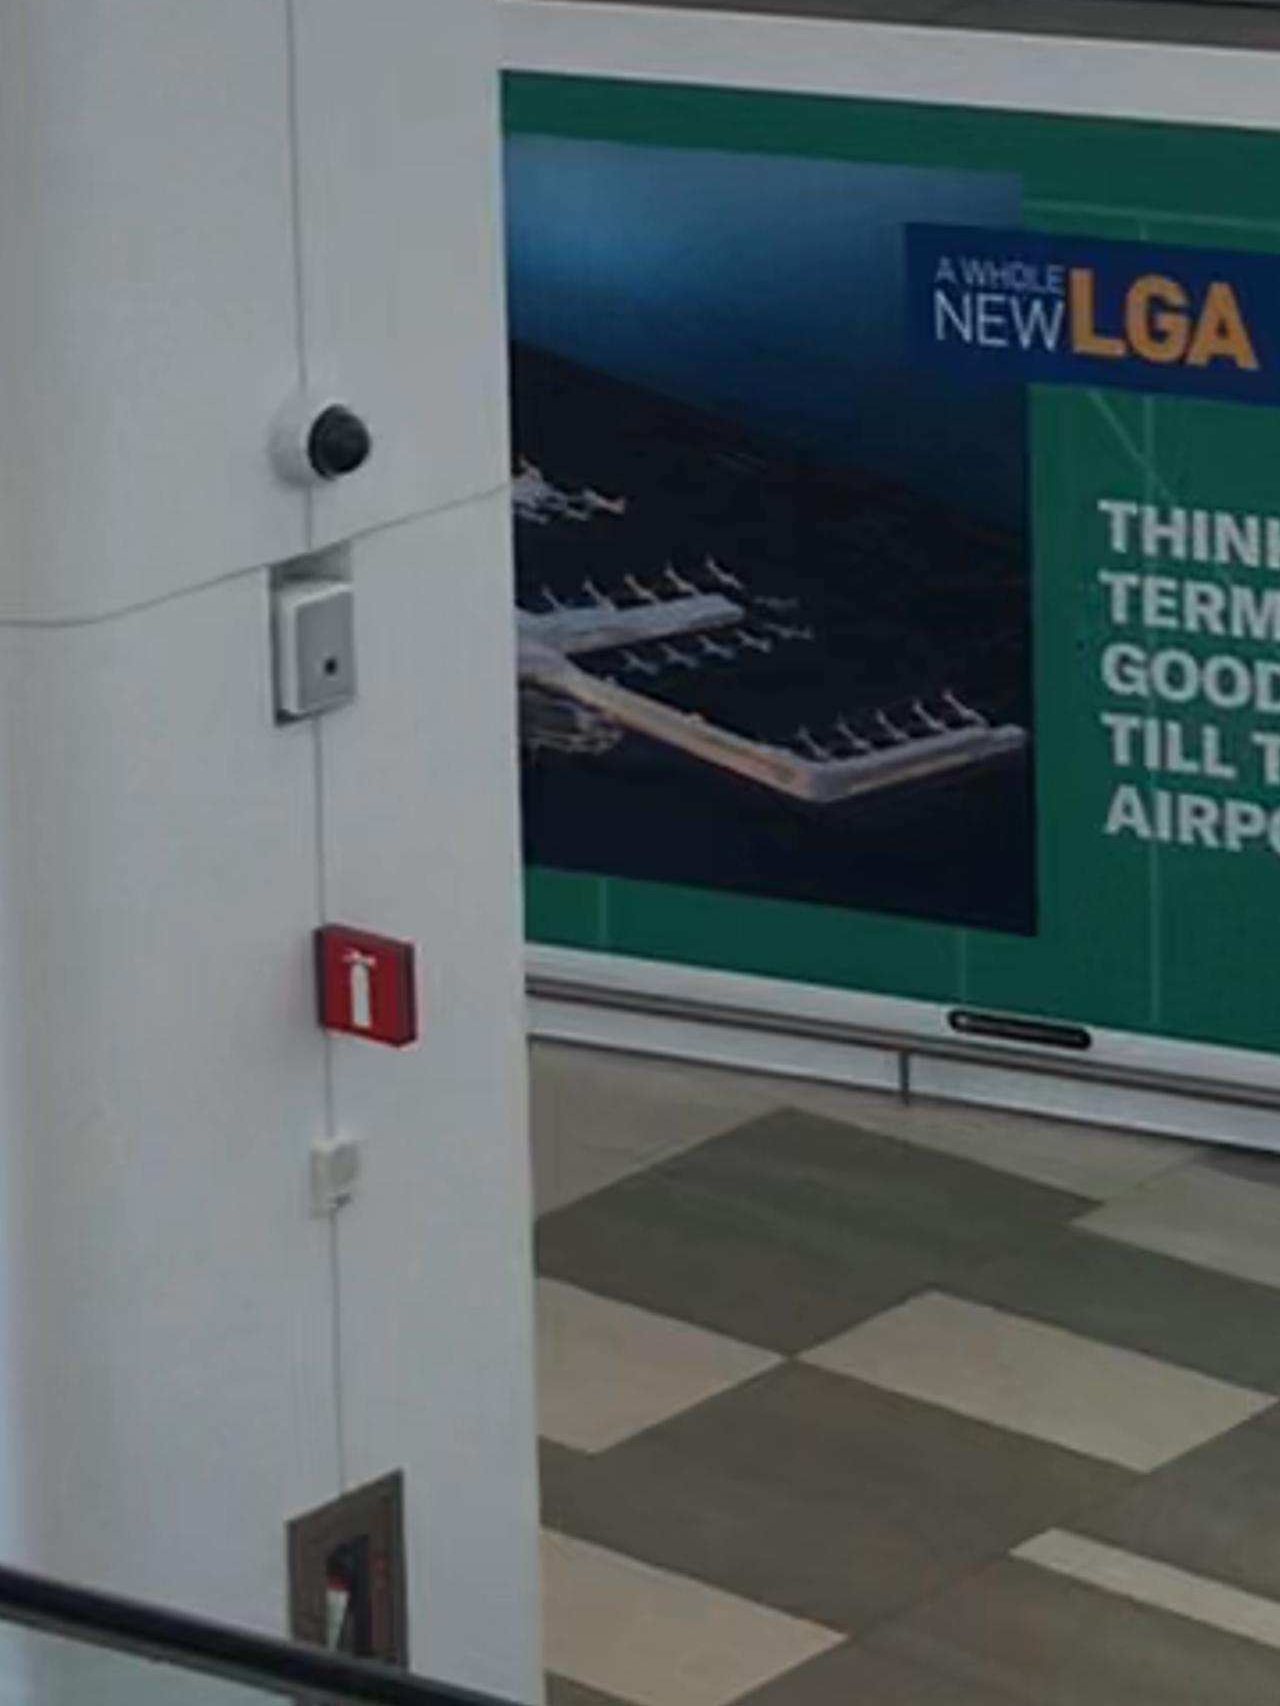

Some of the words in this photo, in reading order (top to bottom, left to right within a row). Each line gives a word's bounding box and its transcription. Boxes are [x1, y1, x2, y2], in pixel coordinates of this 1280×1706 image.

[933, 256, 957, 285] A
[959, 257, 1065, 295] WHOLE
[933, 288, 1065, 352] NEW
[1068, 266, 1261, 371] LGA
[1100, 711, 1237, 780] TILL
